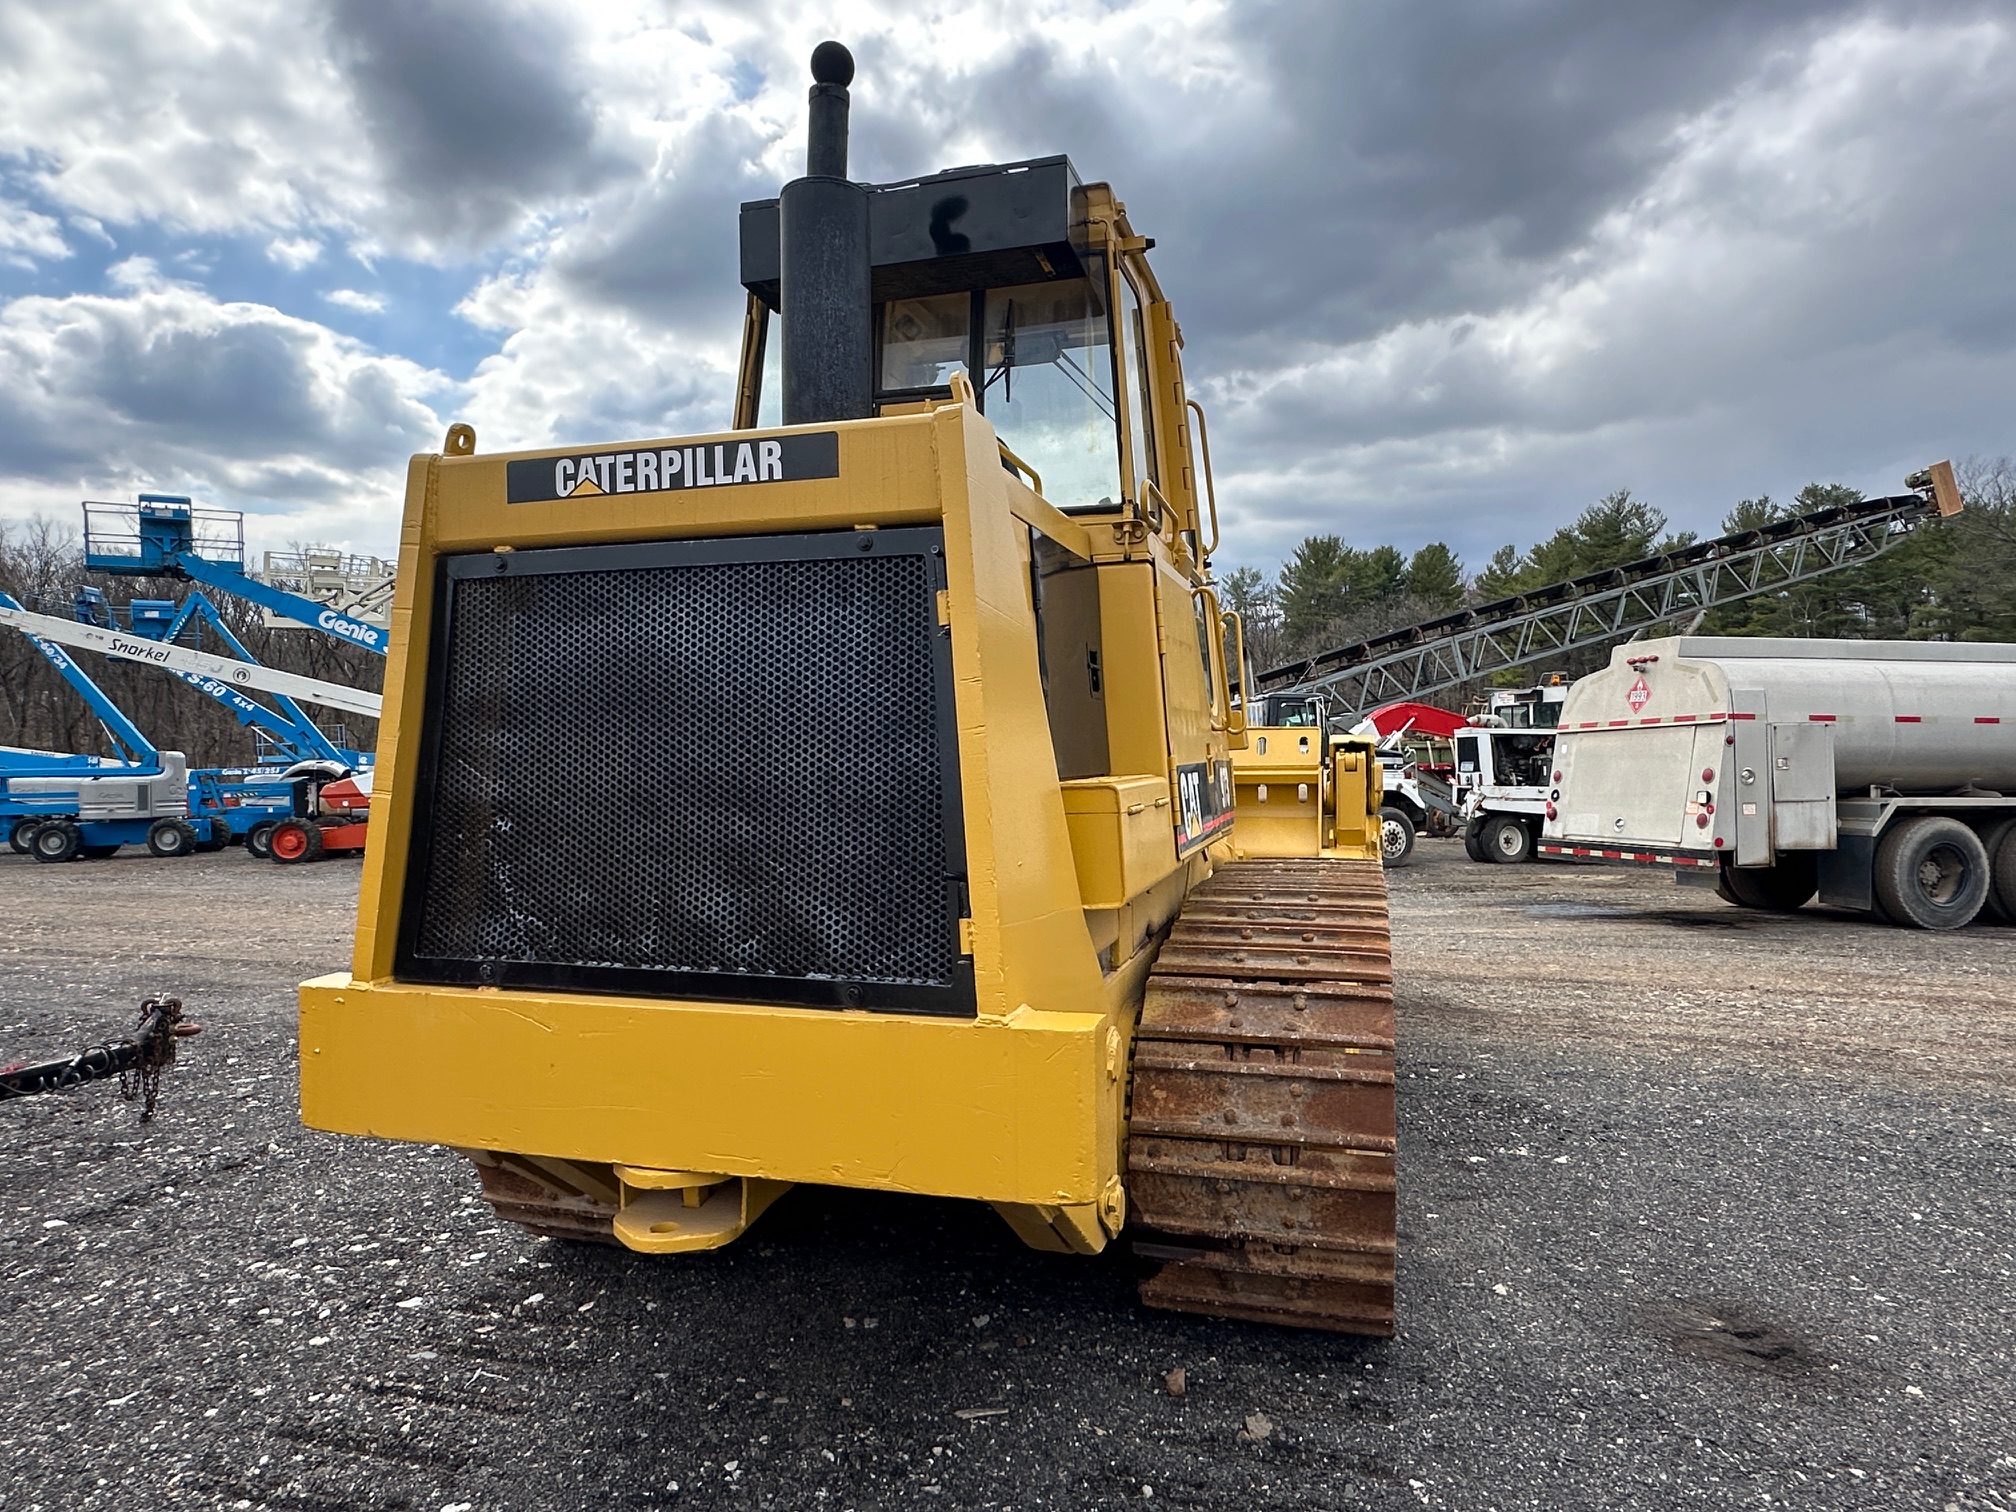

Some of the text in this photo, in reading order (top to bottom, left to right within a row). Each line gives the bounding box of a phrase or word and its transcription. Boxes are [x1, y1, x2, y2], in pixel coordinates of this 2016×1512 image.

[555, 440, 783, 498] CATERPILLAR
[318, 610, 378, 645] Genie
[108, 638, 171, 663] Snorkel
[231, 696, 256, 712] 4x4
[1180, 771, 1203, 840] CAT
